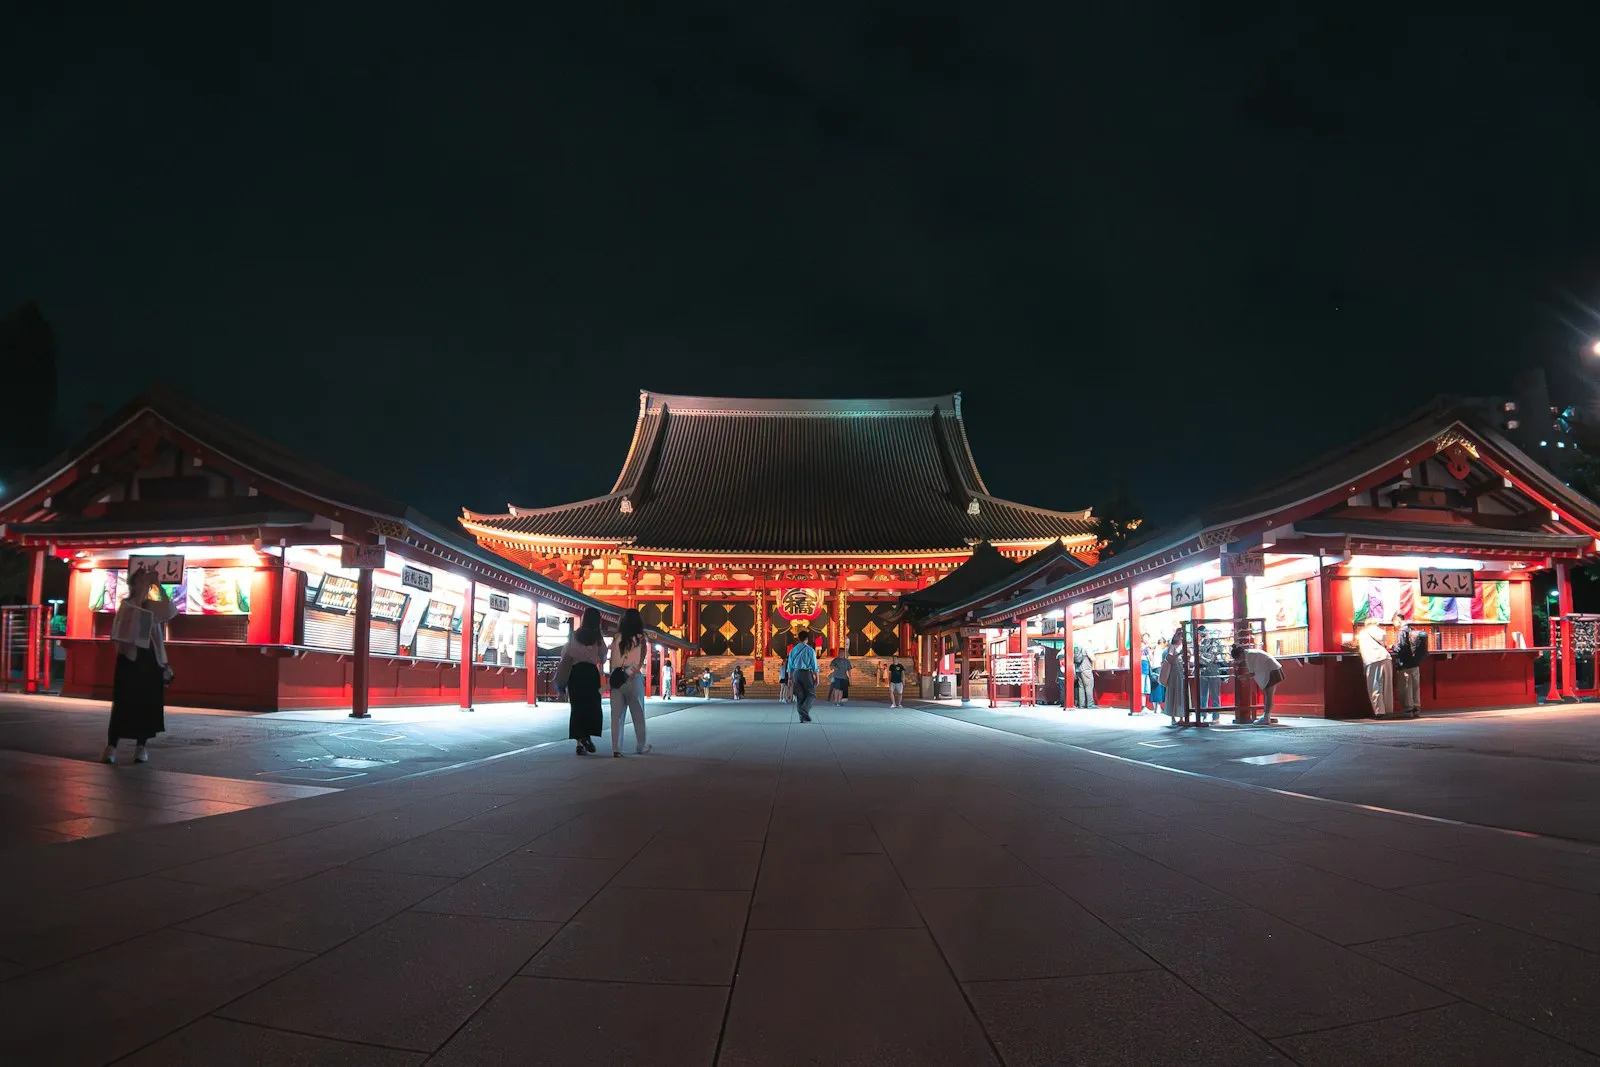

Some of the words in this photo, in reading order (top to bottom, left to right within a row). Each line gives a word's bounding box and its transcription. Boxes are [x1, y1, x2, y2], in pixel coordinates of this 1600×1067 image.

[1426, 574, 1468, 590] みくじ
[1175, 582, 1201, 602] みくじ
